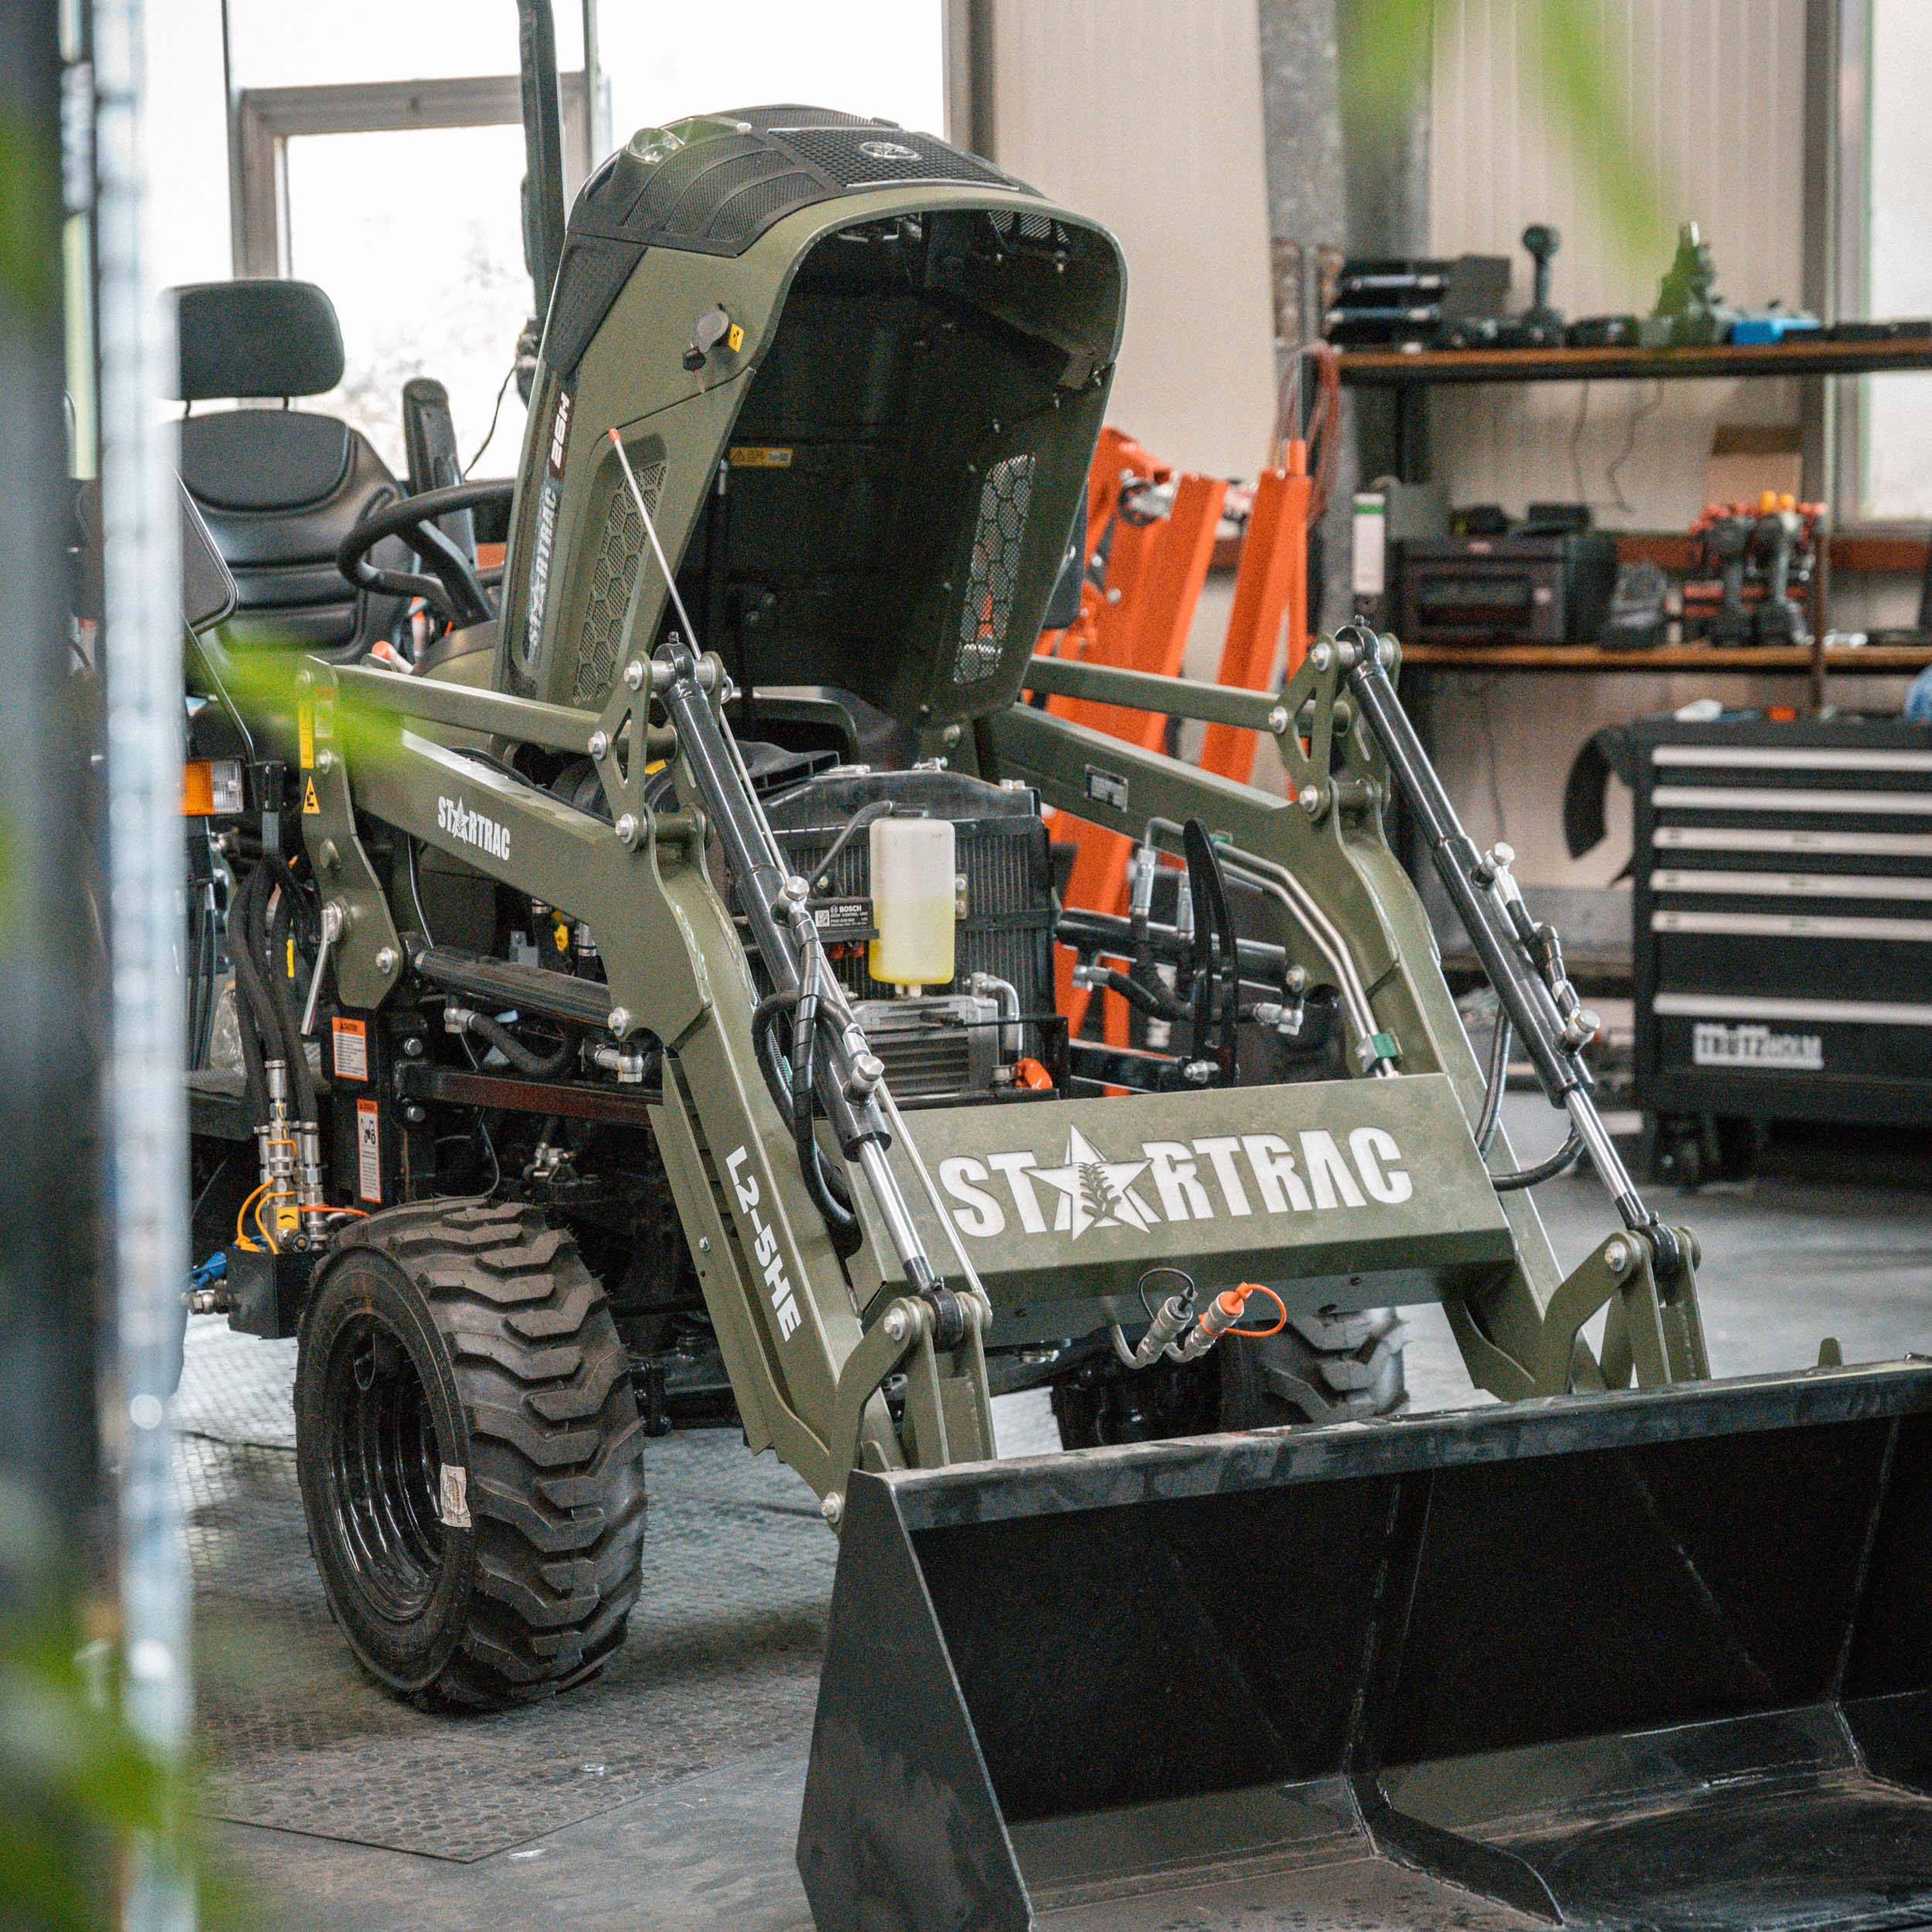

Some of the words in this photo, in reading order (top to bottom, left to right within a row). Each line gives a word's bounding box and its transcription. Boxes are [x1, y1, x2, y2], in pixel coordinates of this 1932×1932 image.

[550, 391, 570, 470] 26H
[839, 905, 862, 913] BOSCH
[939, 1122, 1414, 1242] STARTRAC
[725, 1145, 802, 1342] L2-5HE
